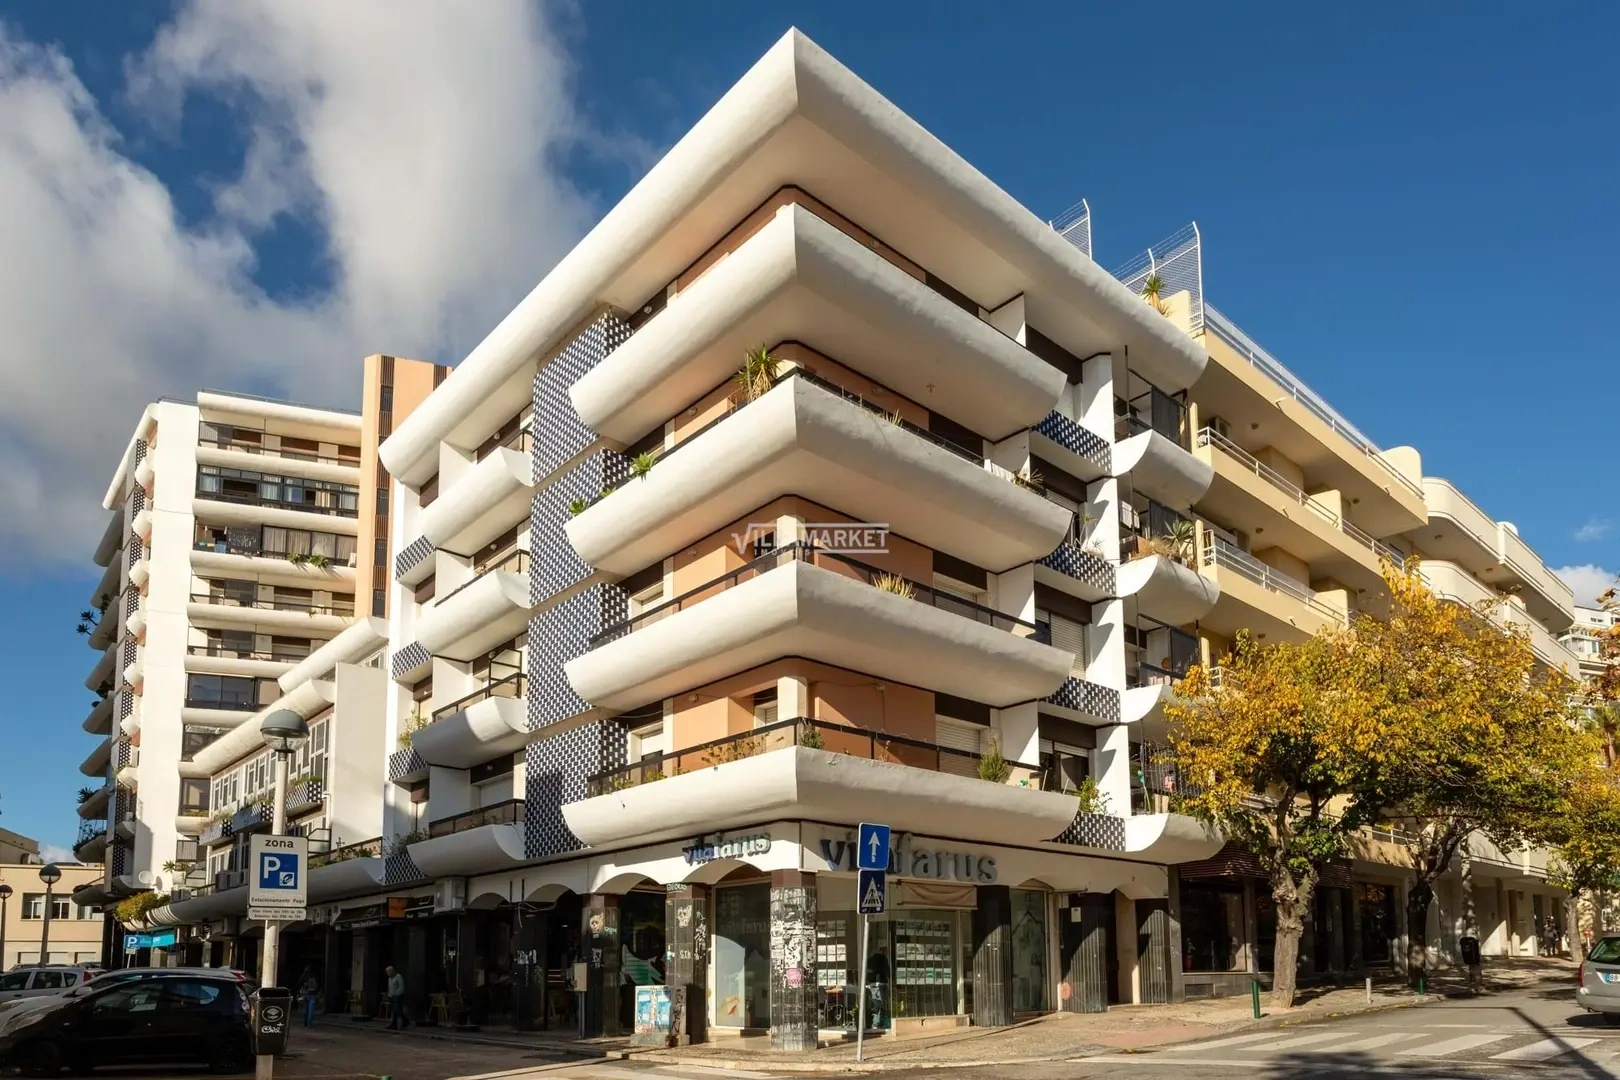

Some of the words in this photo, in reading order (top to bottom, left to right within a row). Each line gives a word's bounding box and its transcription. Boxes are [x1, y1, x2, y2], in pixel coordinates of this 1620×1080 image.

[265, 839, 294, 849] zona
[820, 832, 997, 883] vifarus
[263, 856, 281, 879] P
[127, 936, 138, 948] P
